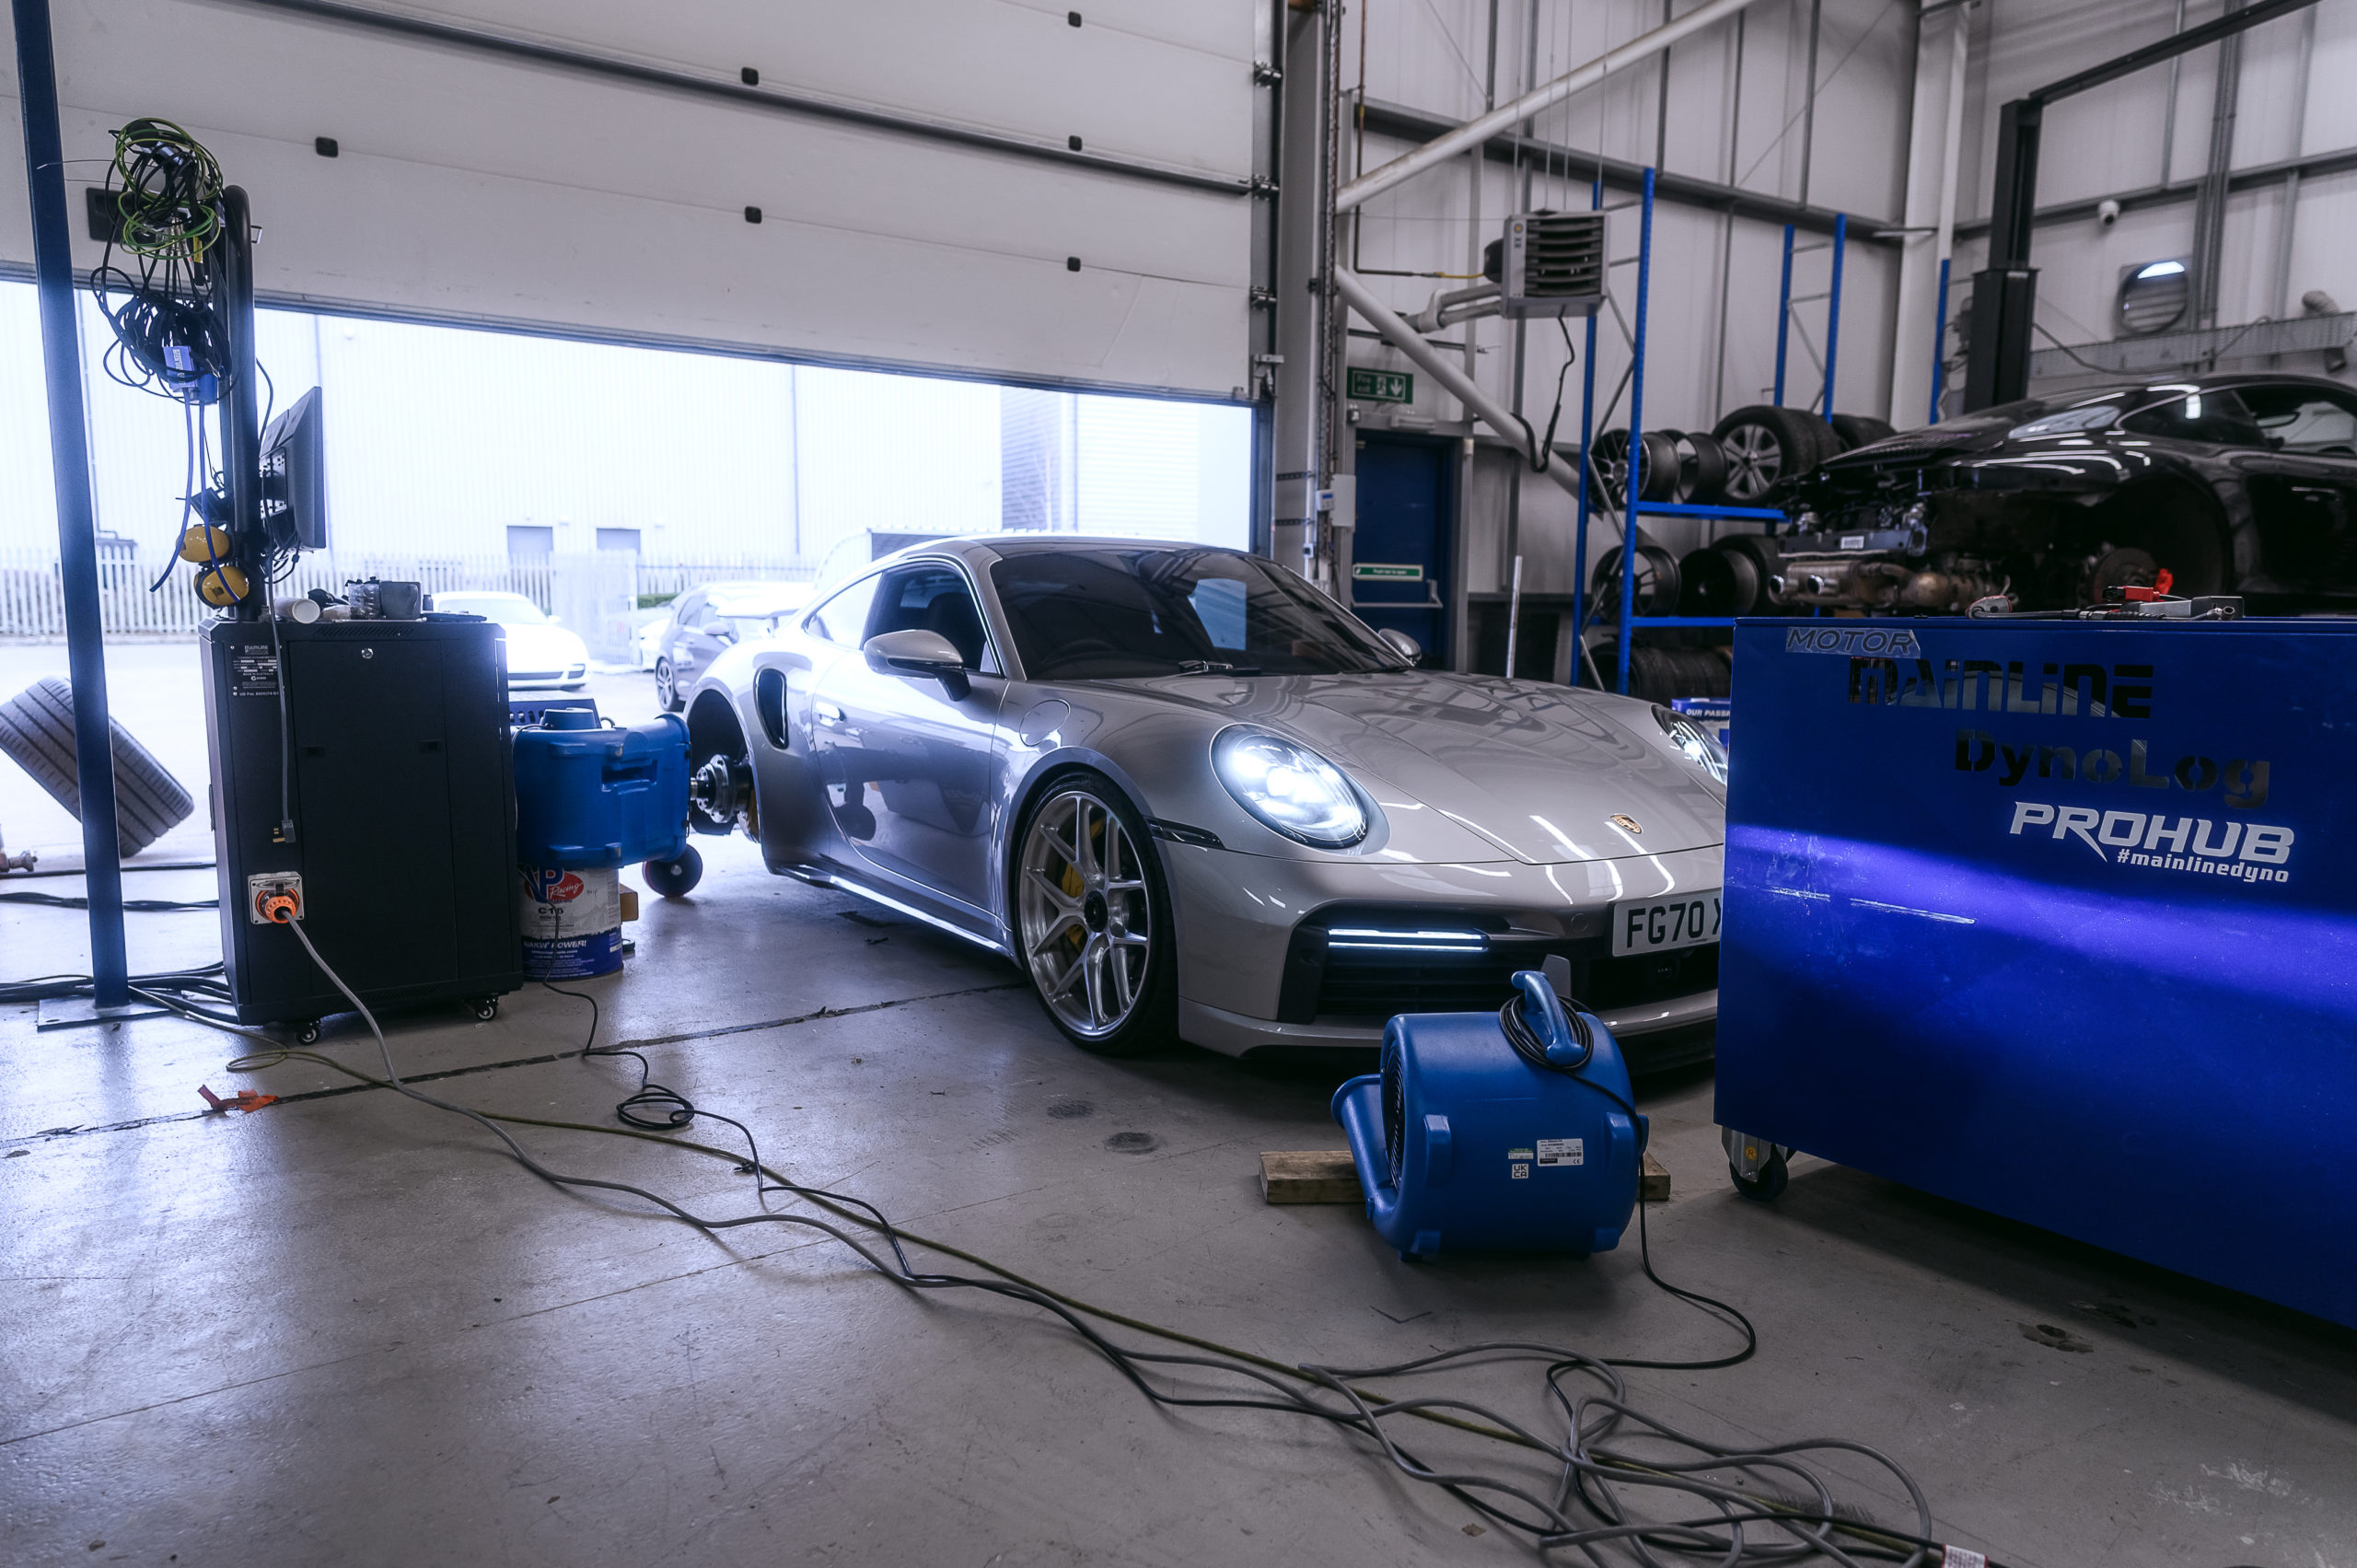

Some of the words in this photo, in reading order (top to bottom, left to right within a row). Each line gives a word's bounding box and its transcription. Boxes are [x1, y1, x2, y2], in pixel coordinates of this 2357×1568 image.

[1786, 628, 1916, 655] MOTOR
[1954, 728, 2270, 810] DynoLog
[2009, 801, 2295, 865] PROHUB
[2117, 847, 2290, 884] #mainlinedyno
[550, 883, 583, 900] Racing
[1626, 900, 1705, 949] FG70
